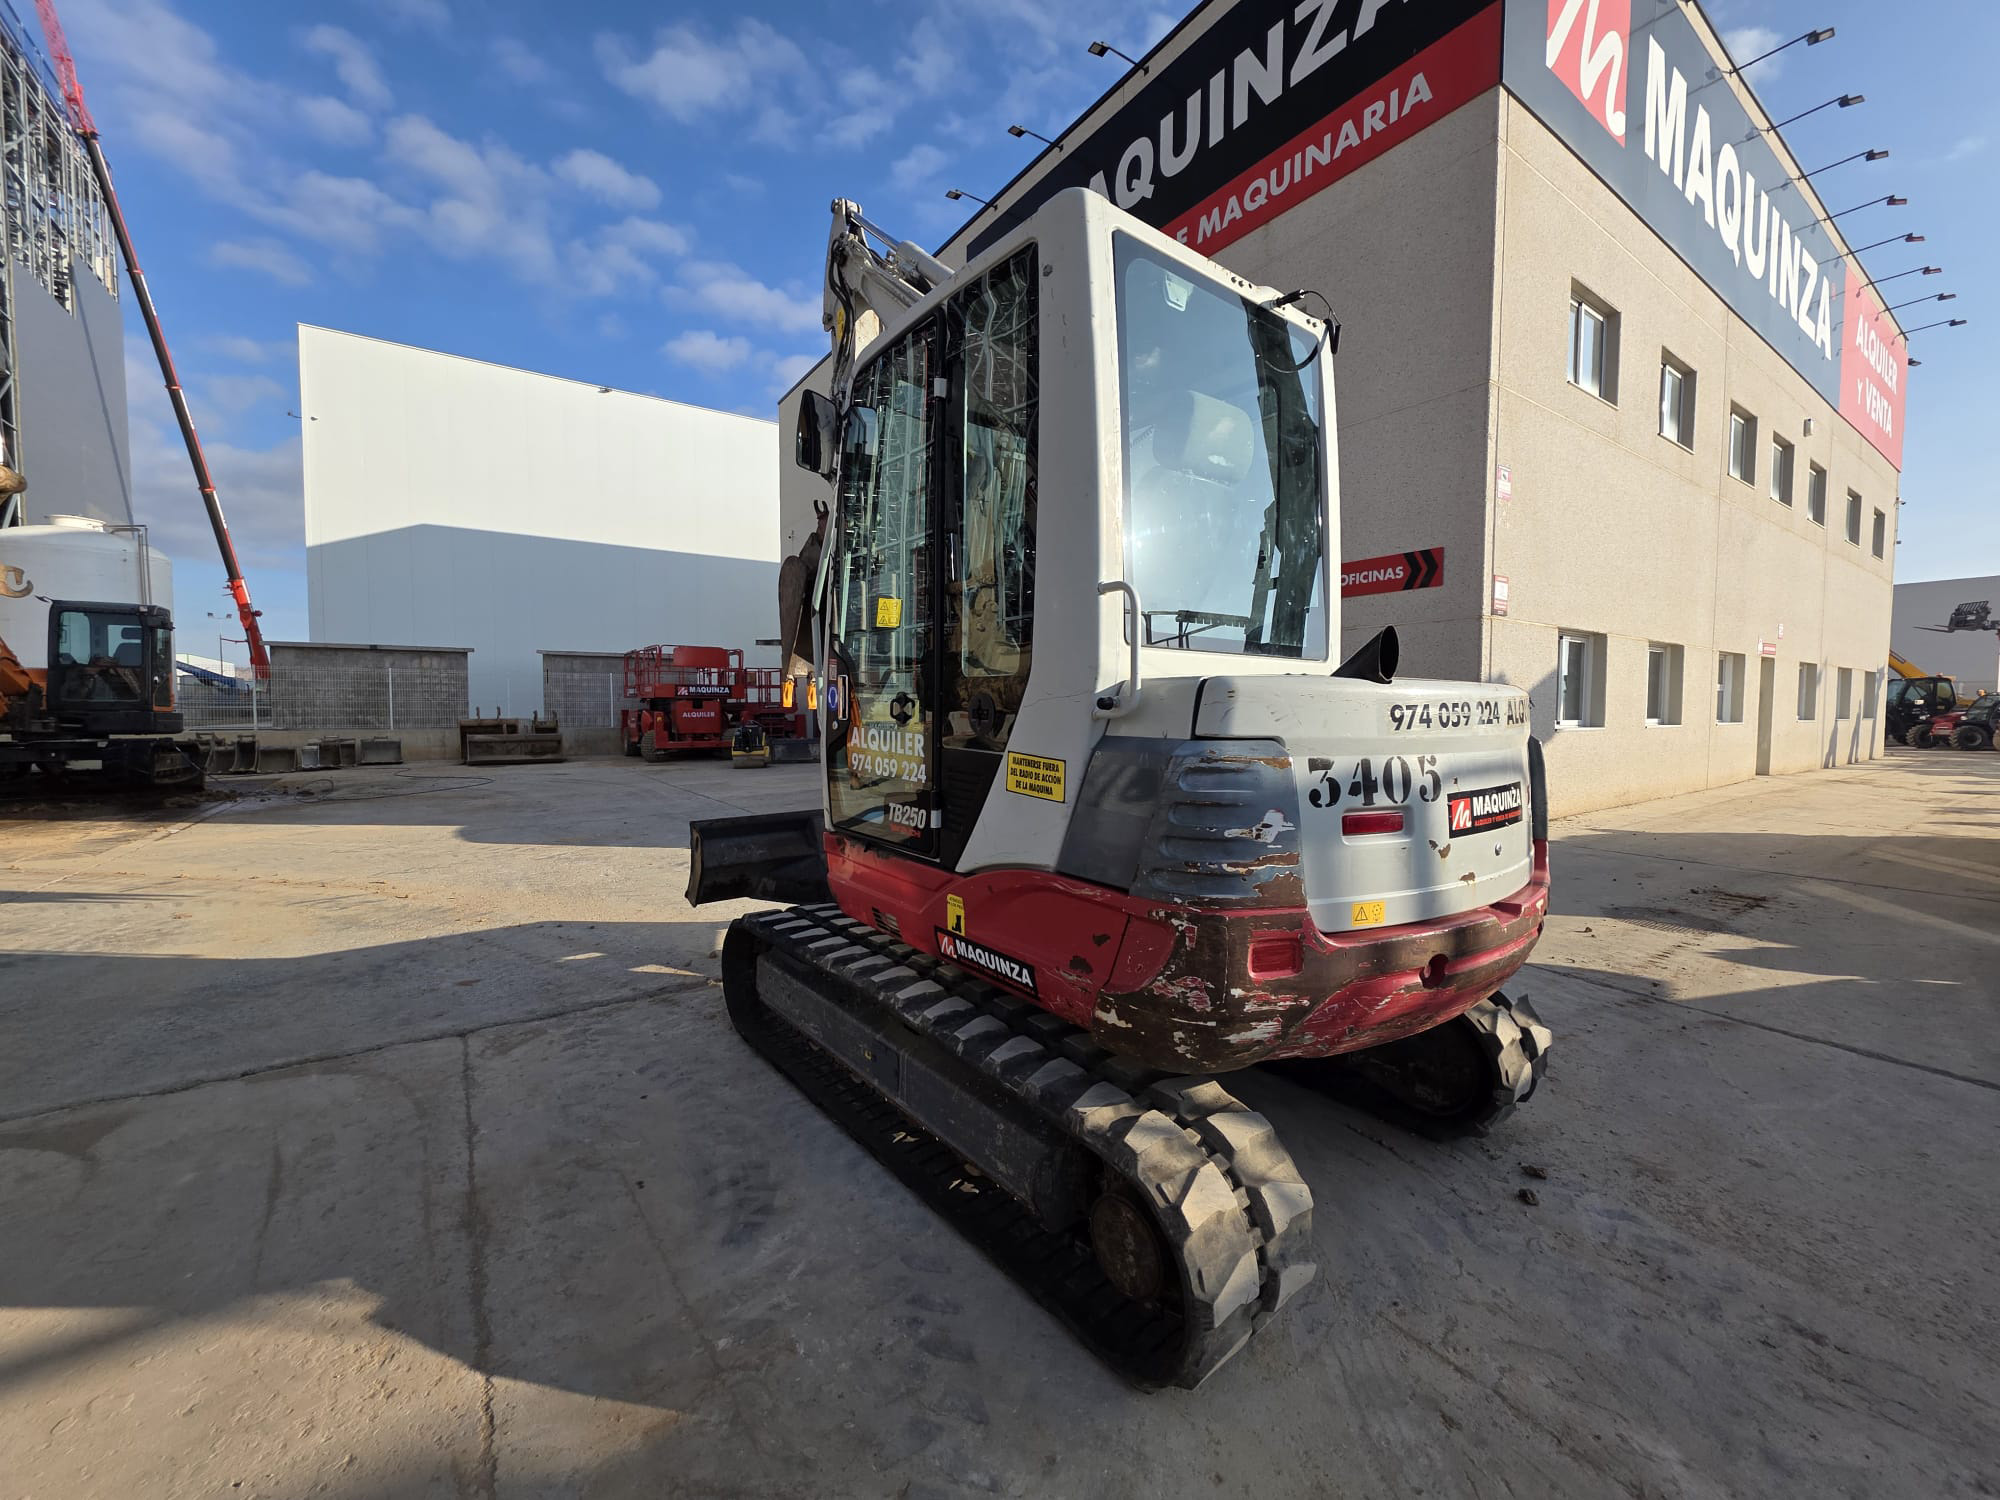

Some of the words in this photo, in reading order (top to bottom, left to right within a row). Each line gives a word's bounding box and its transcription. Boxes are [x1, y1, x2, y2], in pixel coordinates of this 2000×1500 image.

[1197, 72, 1433, 245] MAQUINARIA
[1645, 33, 1832, 361] MAQUINZA
[1855, 314, 1898, 395] ALQUILER
[1857, 379, 1863, 405] Y
[1866, 377, 1893, 439] VENTA
[1341, 566, 1404, 586] OFICINAS
[1390, 704, 1432, 731] 974
[1439, 702, 1471, 728] 059
[1476, 700, 1500, 725] 224
[850, 727, 925, 758] ALQUILER
[852, 752, 872, 773] 974
[875, 756, 898, 778] 059
[902, 760, 927, 783] 224
[1010, 767, 1018, 776] DEL
[1019, 769, 1033, 780] RADIO
[1034, 772, 1040, 781] DE
[1013, 756, 1041, 769] MANTENERSE
[1043, 761, 1059, 773] FUERA
[1016, 780, 1021, 789] DE
[1022, 782, 1028, 790] LA
[1308, 755, 1441, 808] 3405
[889, 802, 926, 829] TB250
[1472, 788, 1521, 816] MAQUINZA
[956, 939, 1033, 988] MAQUINZA
